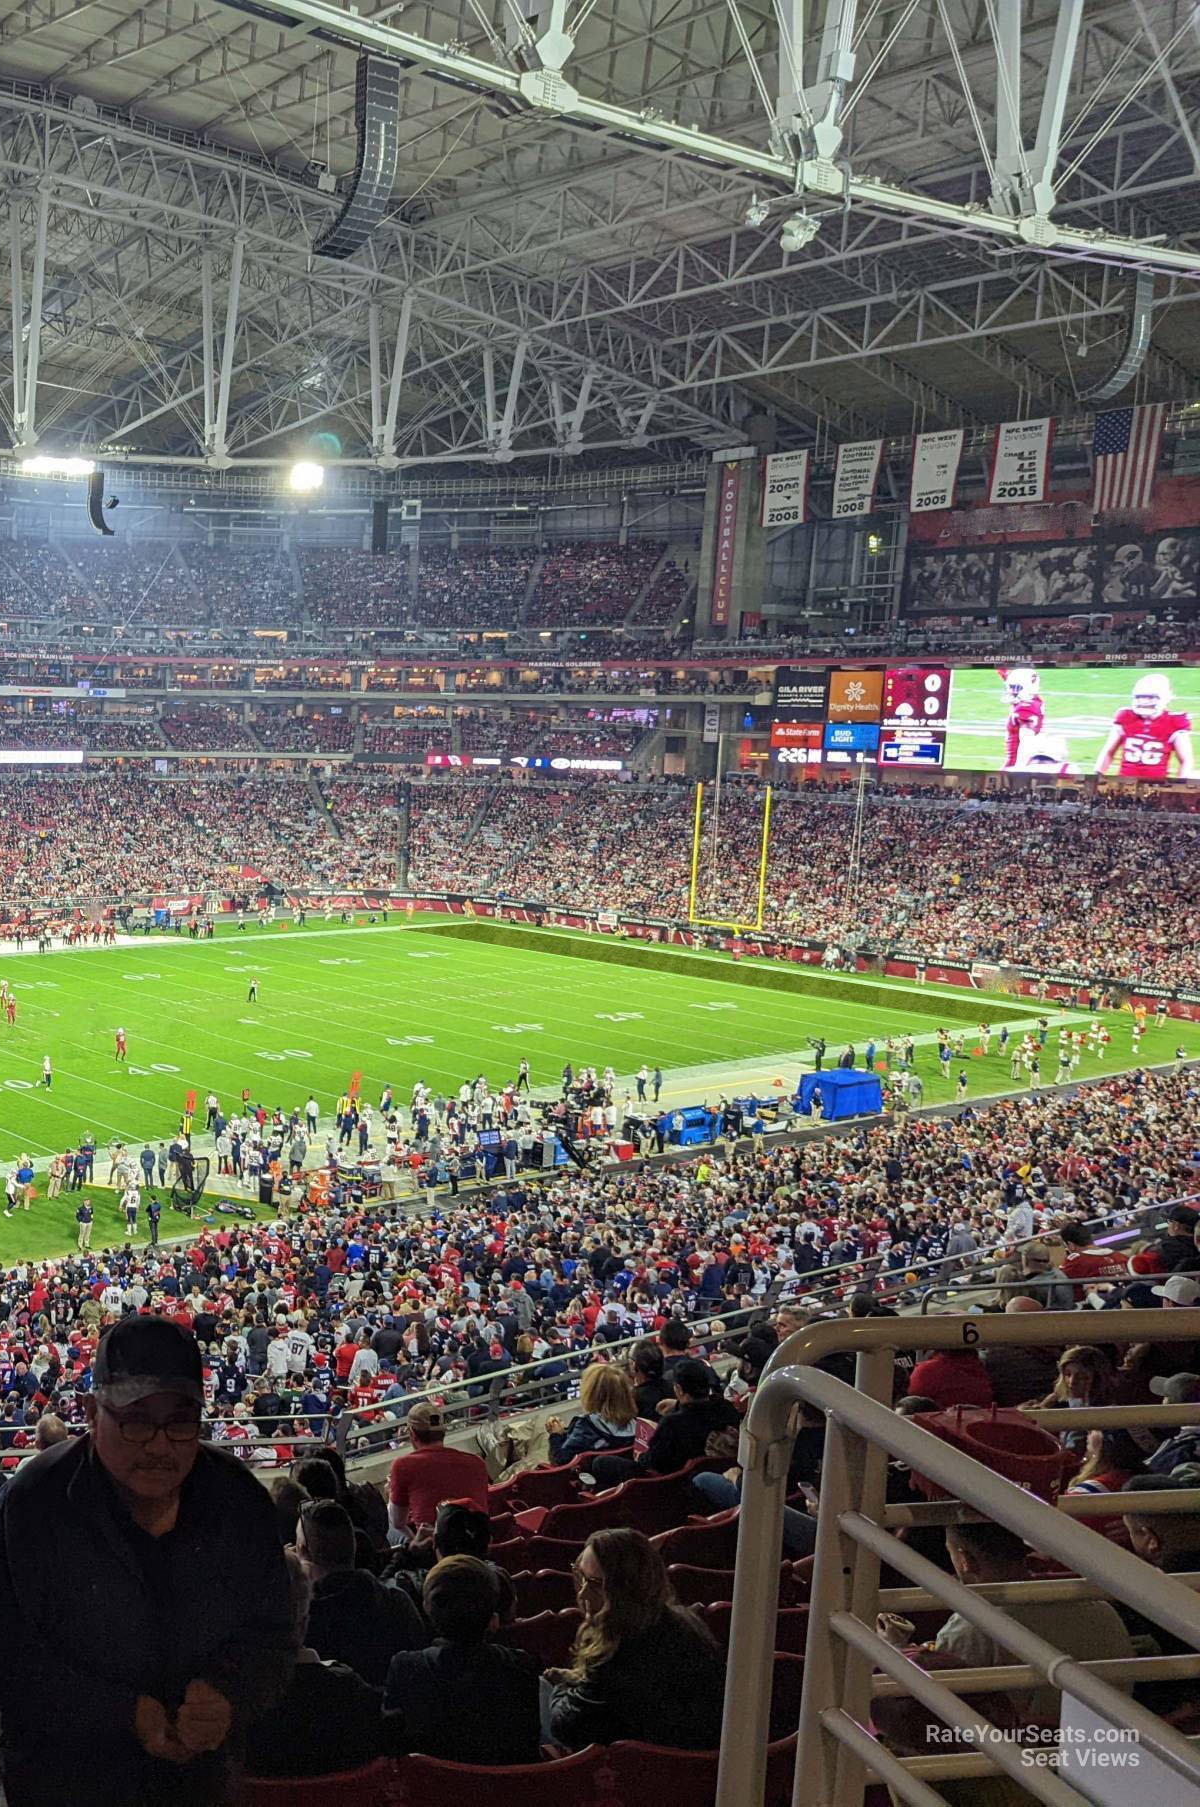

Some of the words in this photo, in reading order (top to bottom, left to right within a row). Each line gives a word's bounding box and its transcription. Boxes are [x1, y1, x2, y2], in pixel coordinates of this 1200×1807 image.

[997, 486, 1037, 498] 2015
[916, 495, 947, 508] 2009
[837, 502, 864, 514] 2008
[768, 511, 799, 522] 2008
[720, 479, 735, 573] FOOTBALL
[716, 576, 726, 621] CLUB
[829, 703, 854, 712] Dignity
[830, 735, 855, 743] LIGHT
[893, 954, 925, 963] ARIZONA
[928, 958, 969, 969] CARDINALS
[1045, 976, 1089, 986] CARDINALS
[1133, 987, 1172, 997] ARIZONA
[255, 1049, 313, 1061] 50
[128, 1063, 181, 1076] 40
[291, 1240, 300, 1250] 12
[369, 1254, 379, 1264] 81
[110, 1295, 119, 1304] 10
[962, 1322, 979, 1344] 6
[291, 1343, 304, 1356] 87
[226, 1379, 235, 1392] 9
